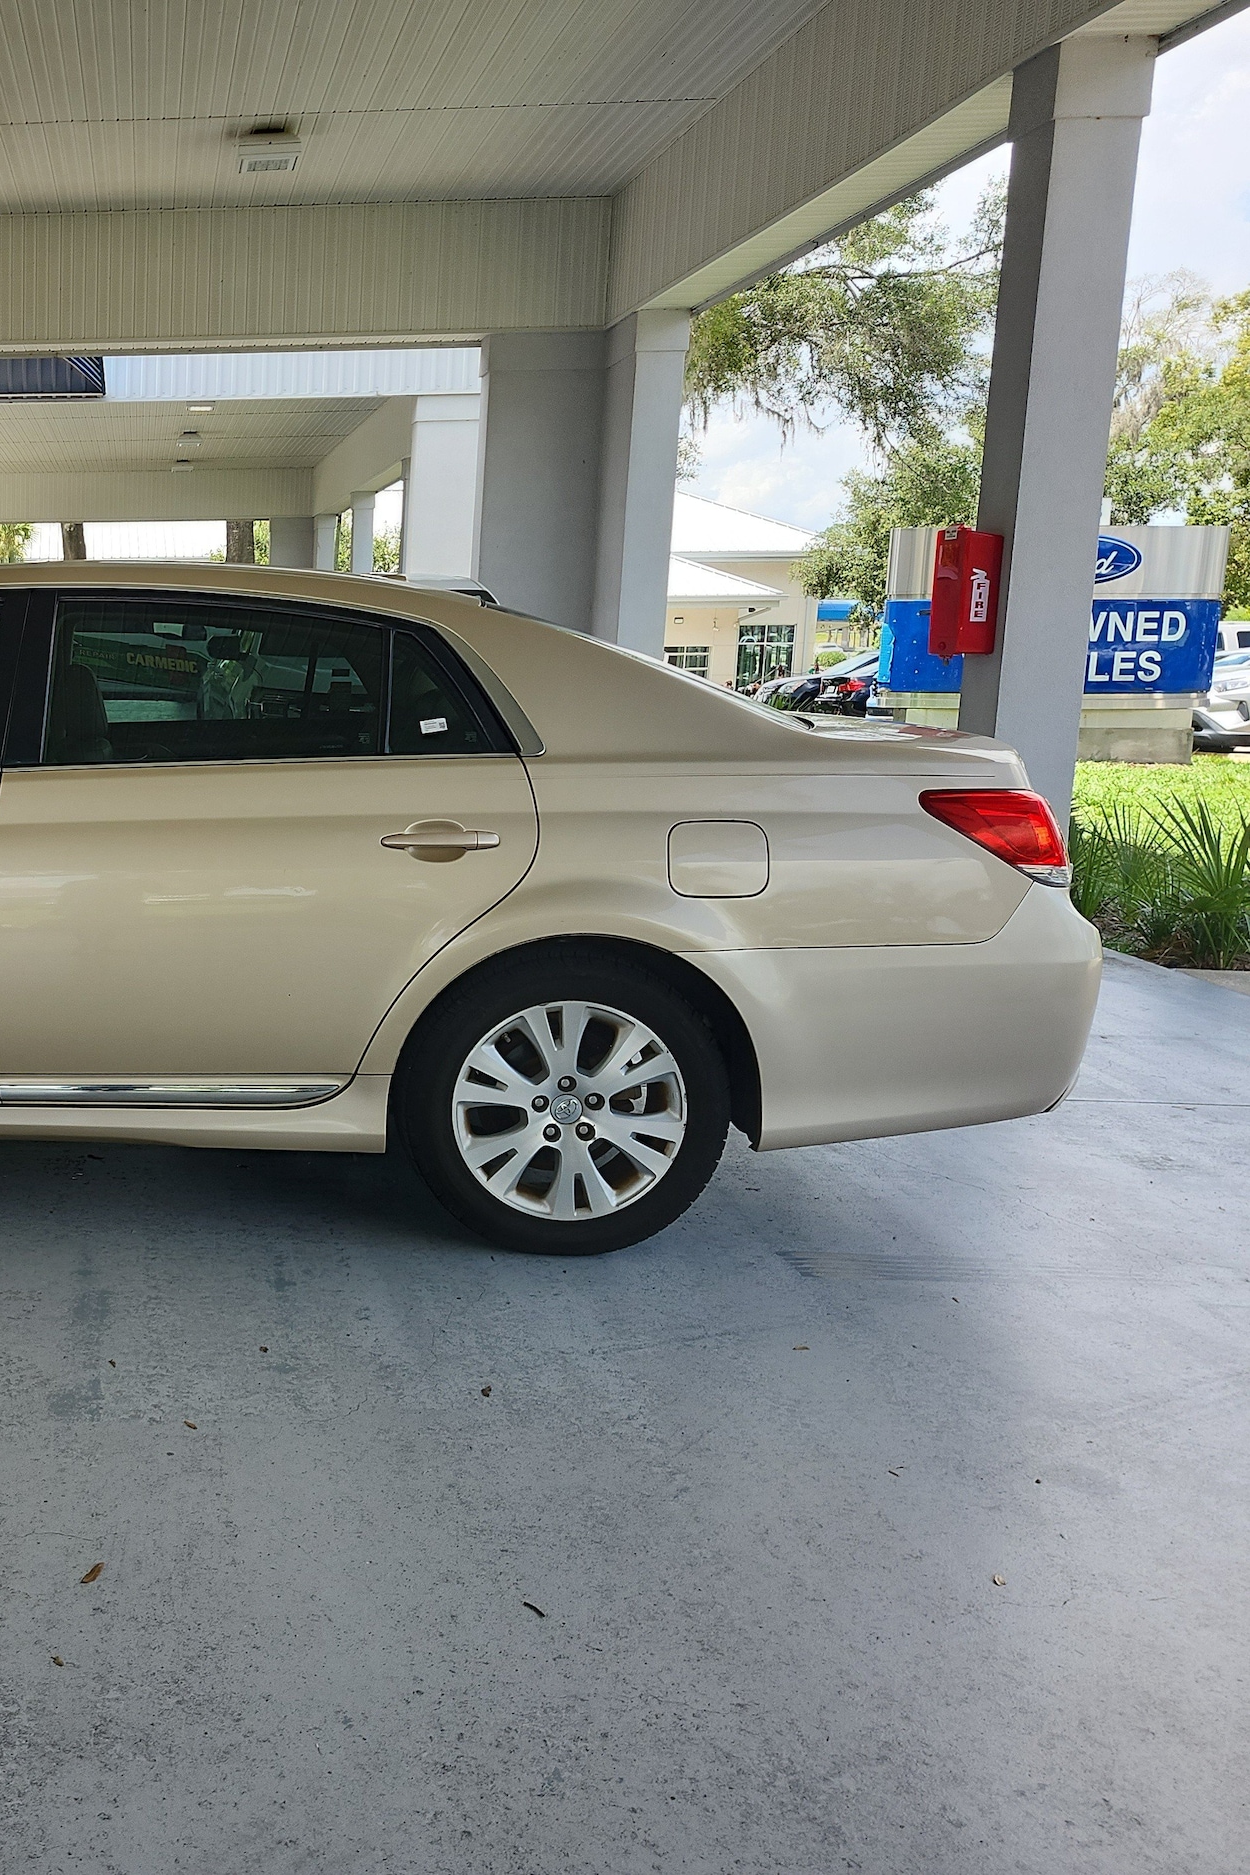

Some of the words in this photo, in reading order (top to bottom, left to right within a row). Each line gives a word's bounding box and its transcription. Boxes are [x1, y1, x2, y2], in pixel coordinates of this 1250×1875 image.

[973, 582, 986, 618] FIRE
[79, 649, 117, 660] REPAIR
[126, 651, 198, 673] CARMEDIC
